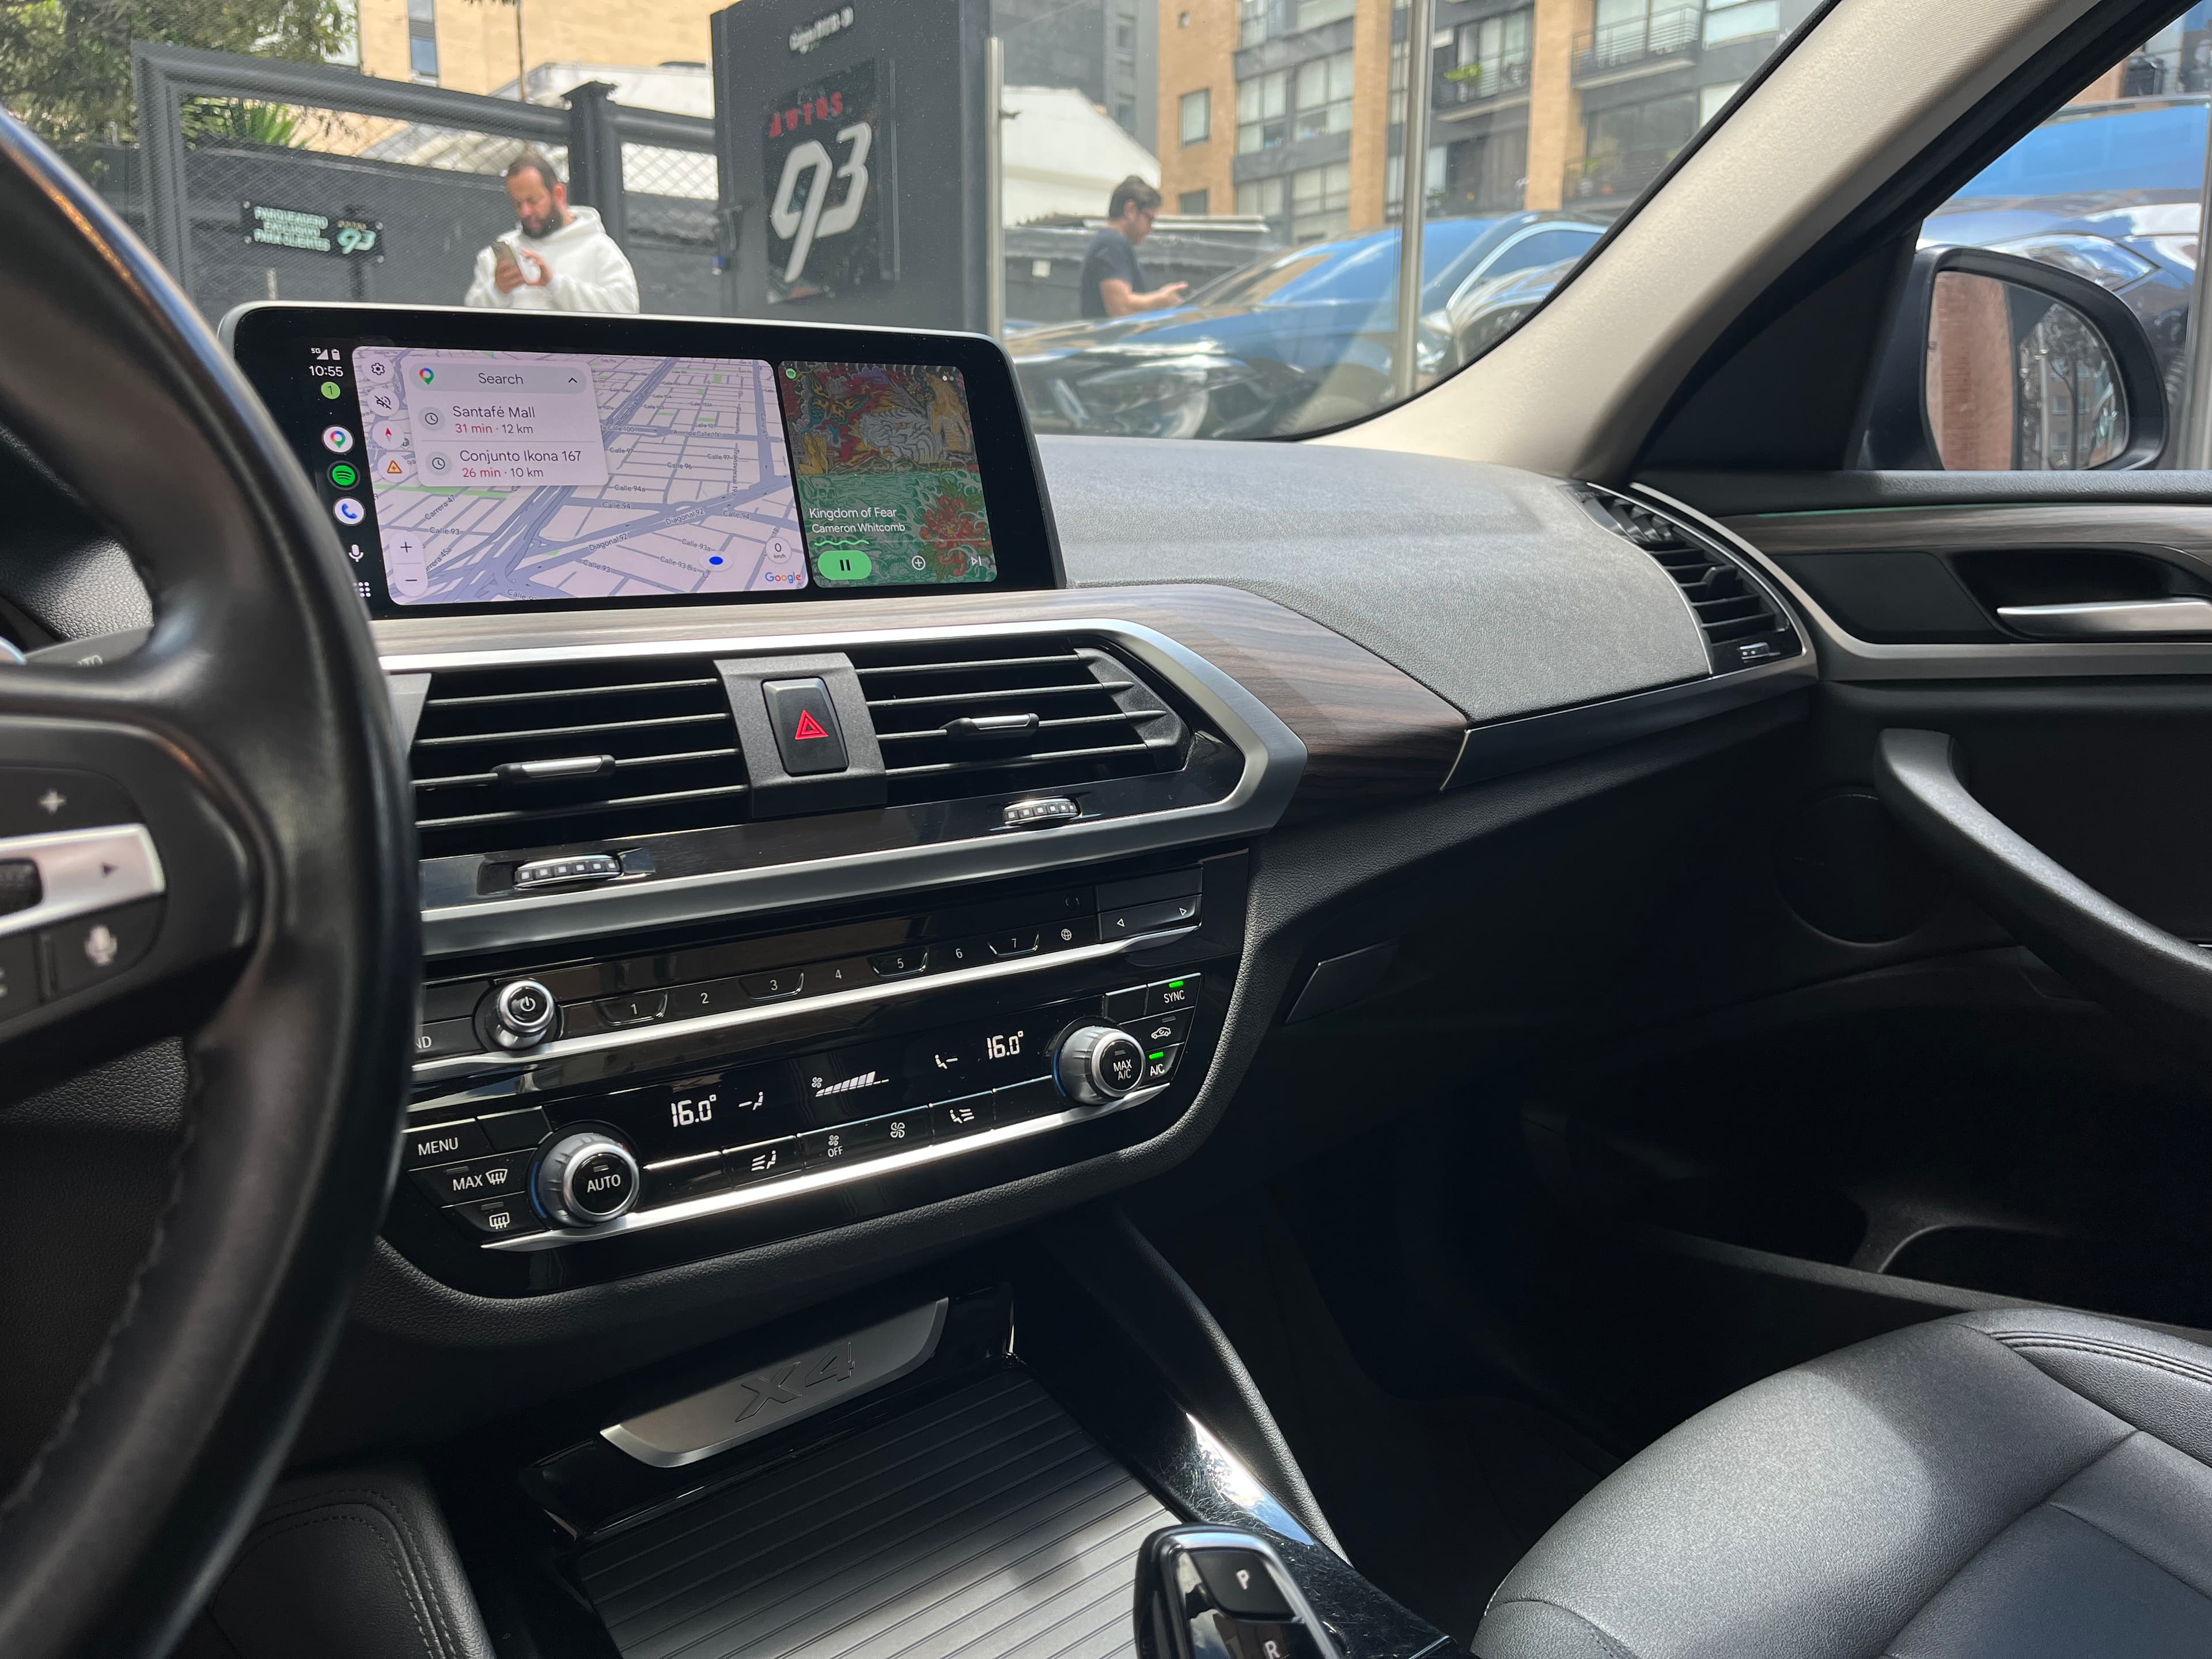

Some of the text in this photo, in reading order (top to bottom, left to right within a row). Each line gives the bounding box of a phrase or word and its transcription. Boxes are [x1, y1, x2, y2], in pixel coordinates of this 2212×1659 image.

[769, 92, 843, 138] AUTOS
[771, 122, 872, 283] 93
[336, 227, 376, 255] 93
[309, 365, 343, 377] 10:55
[478, 373, 524, 385] Search
[453, 406, 535, 418] Santafé Mall
[456, 423, 533, 434] 31 min 12 km
[460, 449, 581, 464] Conjunto Ikona 167
[462, 467, 543, 478] 26 min 10 km
[425, 494, 455, 520] Carrera 47
[665, 512, 695, 525] Diagonal
[809, 507, 897, 521] Kingdom of Fear
[429, 527, 449, 535] Calle
[812, 522, 906, 533] Cameron Whitcomb
[589, 536, 619, 551] Diagonal
[681, 539, 711, 552] Calle 93a
[775, 543, 782, 552] 0
[426, 547, 452, 571] rrera 45a
[583, 559, 601, 570] Calle
[660, 556, 676, 566] Calle
[677, 560, 686, 569] 93
[765, 572, 801, 584] Google
[507, 589, 527, 600] Calle
[1012, 938, 1017, 949] 7
[956, 948, 963, 959] 6
[897, 958, 904, 969] 5
[835, 969, 842, 980] 4
[770, 979, 778, 991] 3
[700, 992, 709, 1004] 2
[1163, 990, 1185, 1004] SYNC
[631, 1003, 638, 1015] 1
[1113, 1059, 1133, 1074] MAX
[1149, 1063, 1165, 1077] A/C
[1118, 1069, 1132, 1082] A/C
[418, 1137, 459, 1156] MENU
[827, 1146, 843, 1158] OFF
[452, 1174, 483, 1191] MAX
[586, 1173, 622, 1193] AUTO
[735, 1341, 856, 1423] X4
[1235, 1569, 1251, 1590] P
[1264, 1640, 1281, 1659] R
